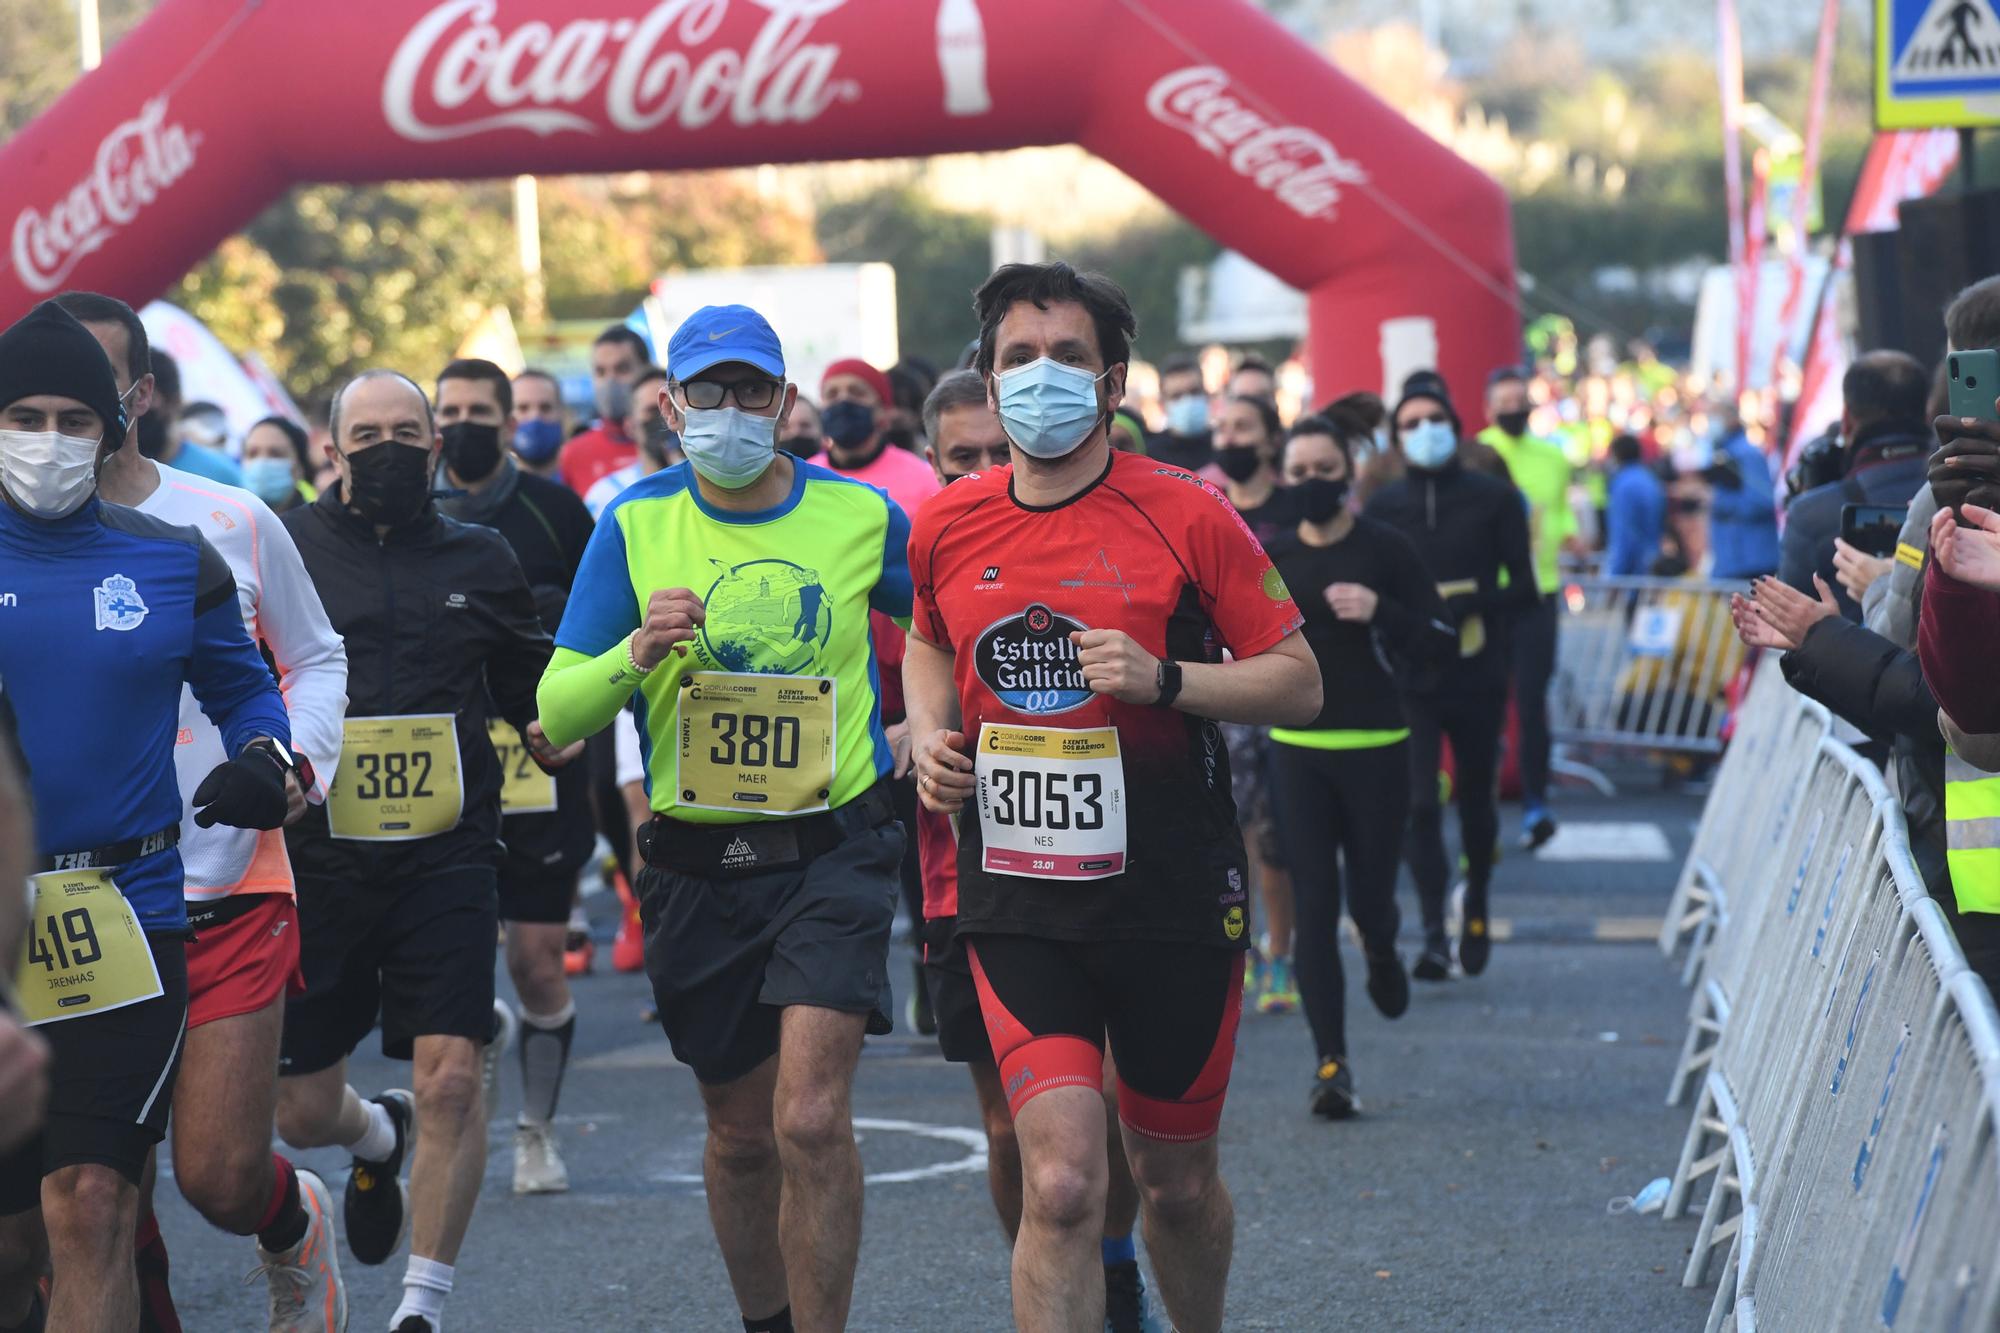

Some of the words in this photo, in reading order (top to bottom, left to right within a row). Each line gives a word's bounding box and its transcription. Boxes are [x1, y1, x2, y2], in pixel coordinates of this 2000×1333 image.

[382, 0, 848, 141] Coca-Cola
[991, 636, 1082, 661] Estrell
[997, 662, 1086, 689] Galicia
[682, 717, 690, 750] TANDA
[710, 712, 800, 769] 380
[357, 751, 434, 800] 382
[738, 773, 767, 784] MAER
[980, 775, 988, 810] TANDA
[991, 768, 1104, 831] 3053
[1034, 836, 1054, 847] NES
[1032, 860, 1054, 870] 23.01
[28, 907, 102, 972] 419
